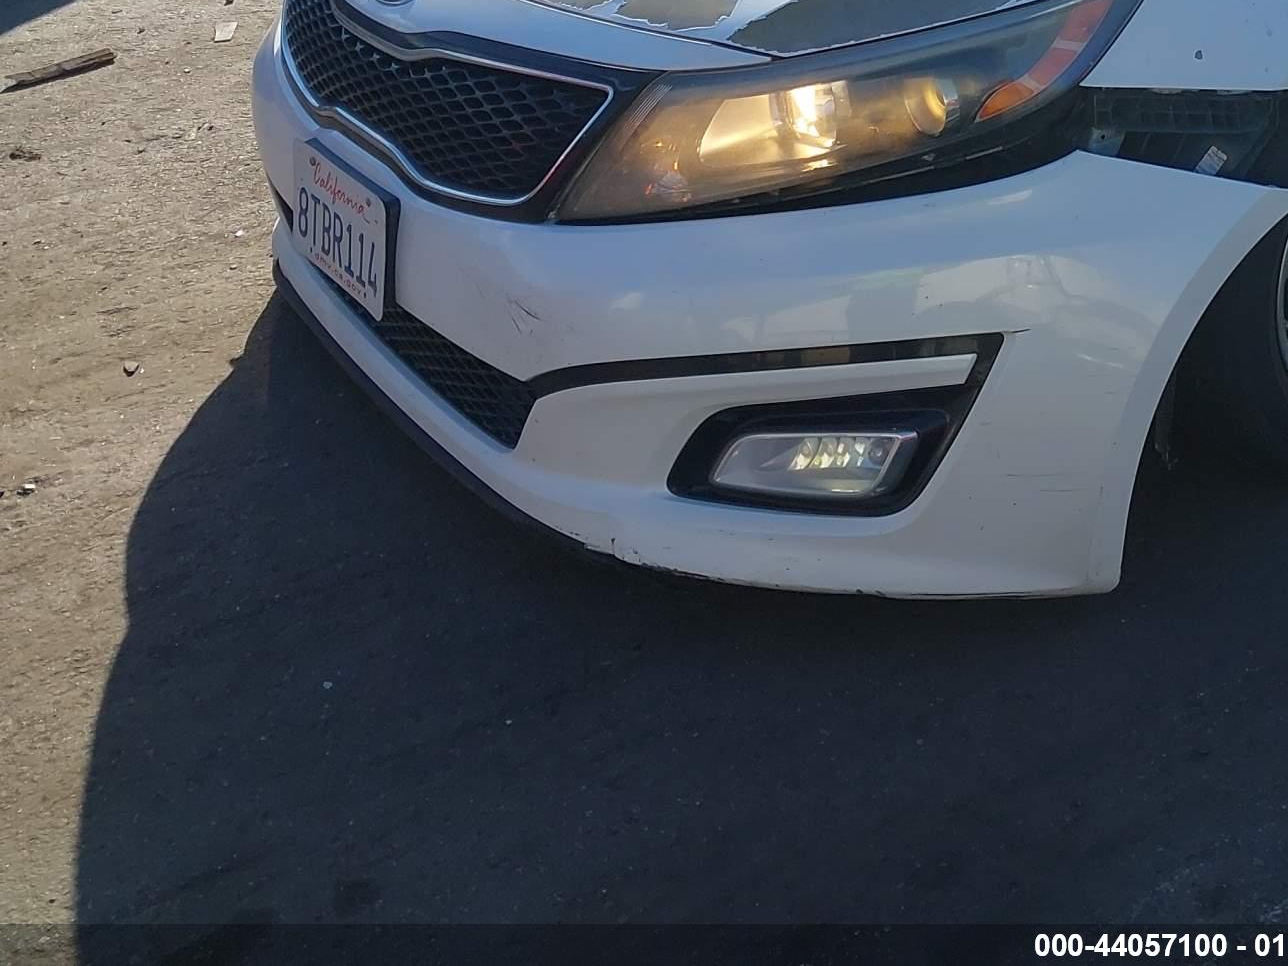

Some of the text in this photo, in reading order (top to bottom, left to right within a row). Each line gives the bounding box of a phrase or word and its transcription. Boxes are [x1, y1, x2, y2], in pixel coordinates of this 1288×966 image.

[313, 161, 369, 217] California
[298, 186, 378, 299] 8TBR114
[314, 251, 363, 296] dmv.ca.gov
